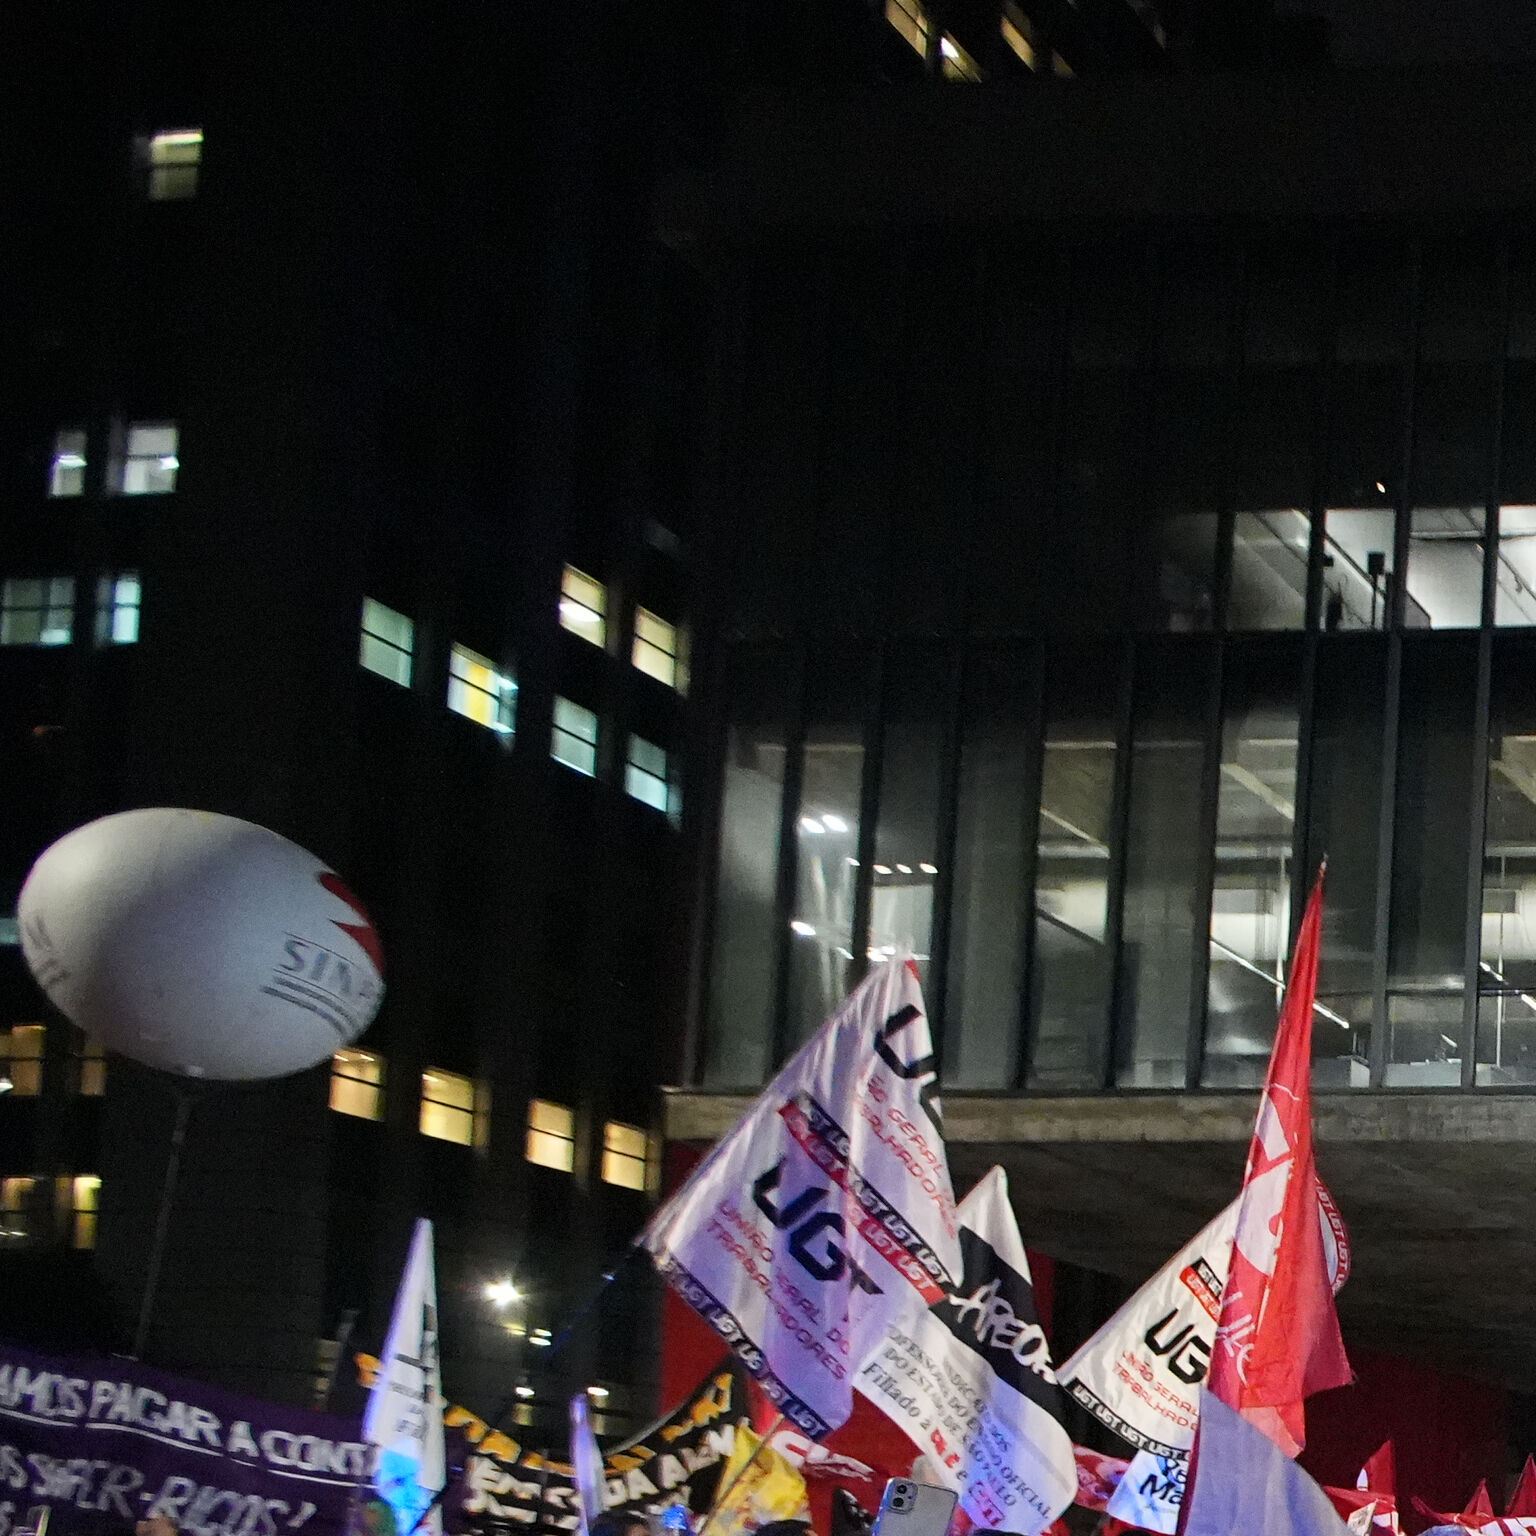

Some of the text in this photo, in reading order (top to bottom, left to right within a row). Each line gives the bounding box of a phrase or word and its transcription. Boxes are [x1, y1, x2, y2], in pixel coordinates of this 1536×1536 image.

[754, 1157, 885, 1293] UGT
[865, 1223, 902, 1260] UGT
[896, 1253, 939, 1295] UGT
[881, 1212, 920, 1251] UGT
[914, 1247, 955, 1287] UGT
[1327, 1211, 1347, 1239] UGT
[1338, 1241, 1349, 1270] UGT
[706, 1306, 746, 1346] UGT
[787, 1402, 825, 1440] UGT
[1144, 1308, 1212, 1384] UG
[89, 1380, 224, 1447] PAGAR
[227, 1420, 260, 1457] A
[861, 1360, 926, 1419] Filiado
[1074, 1386, 1099, 1410] UGT
[1098, 1404, 1124, 1430] UGT
[1121, 1424, 1147, 1448] UGT
